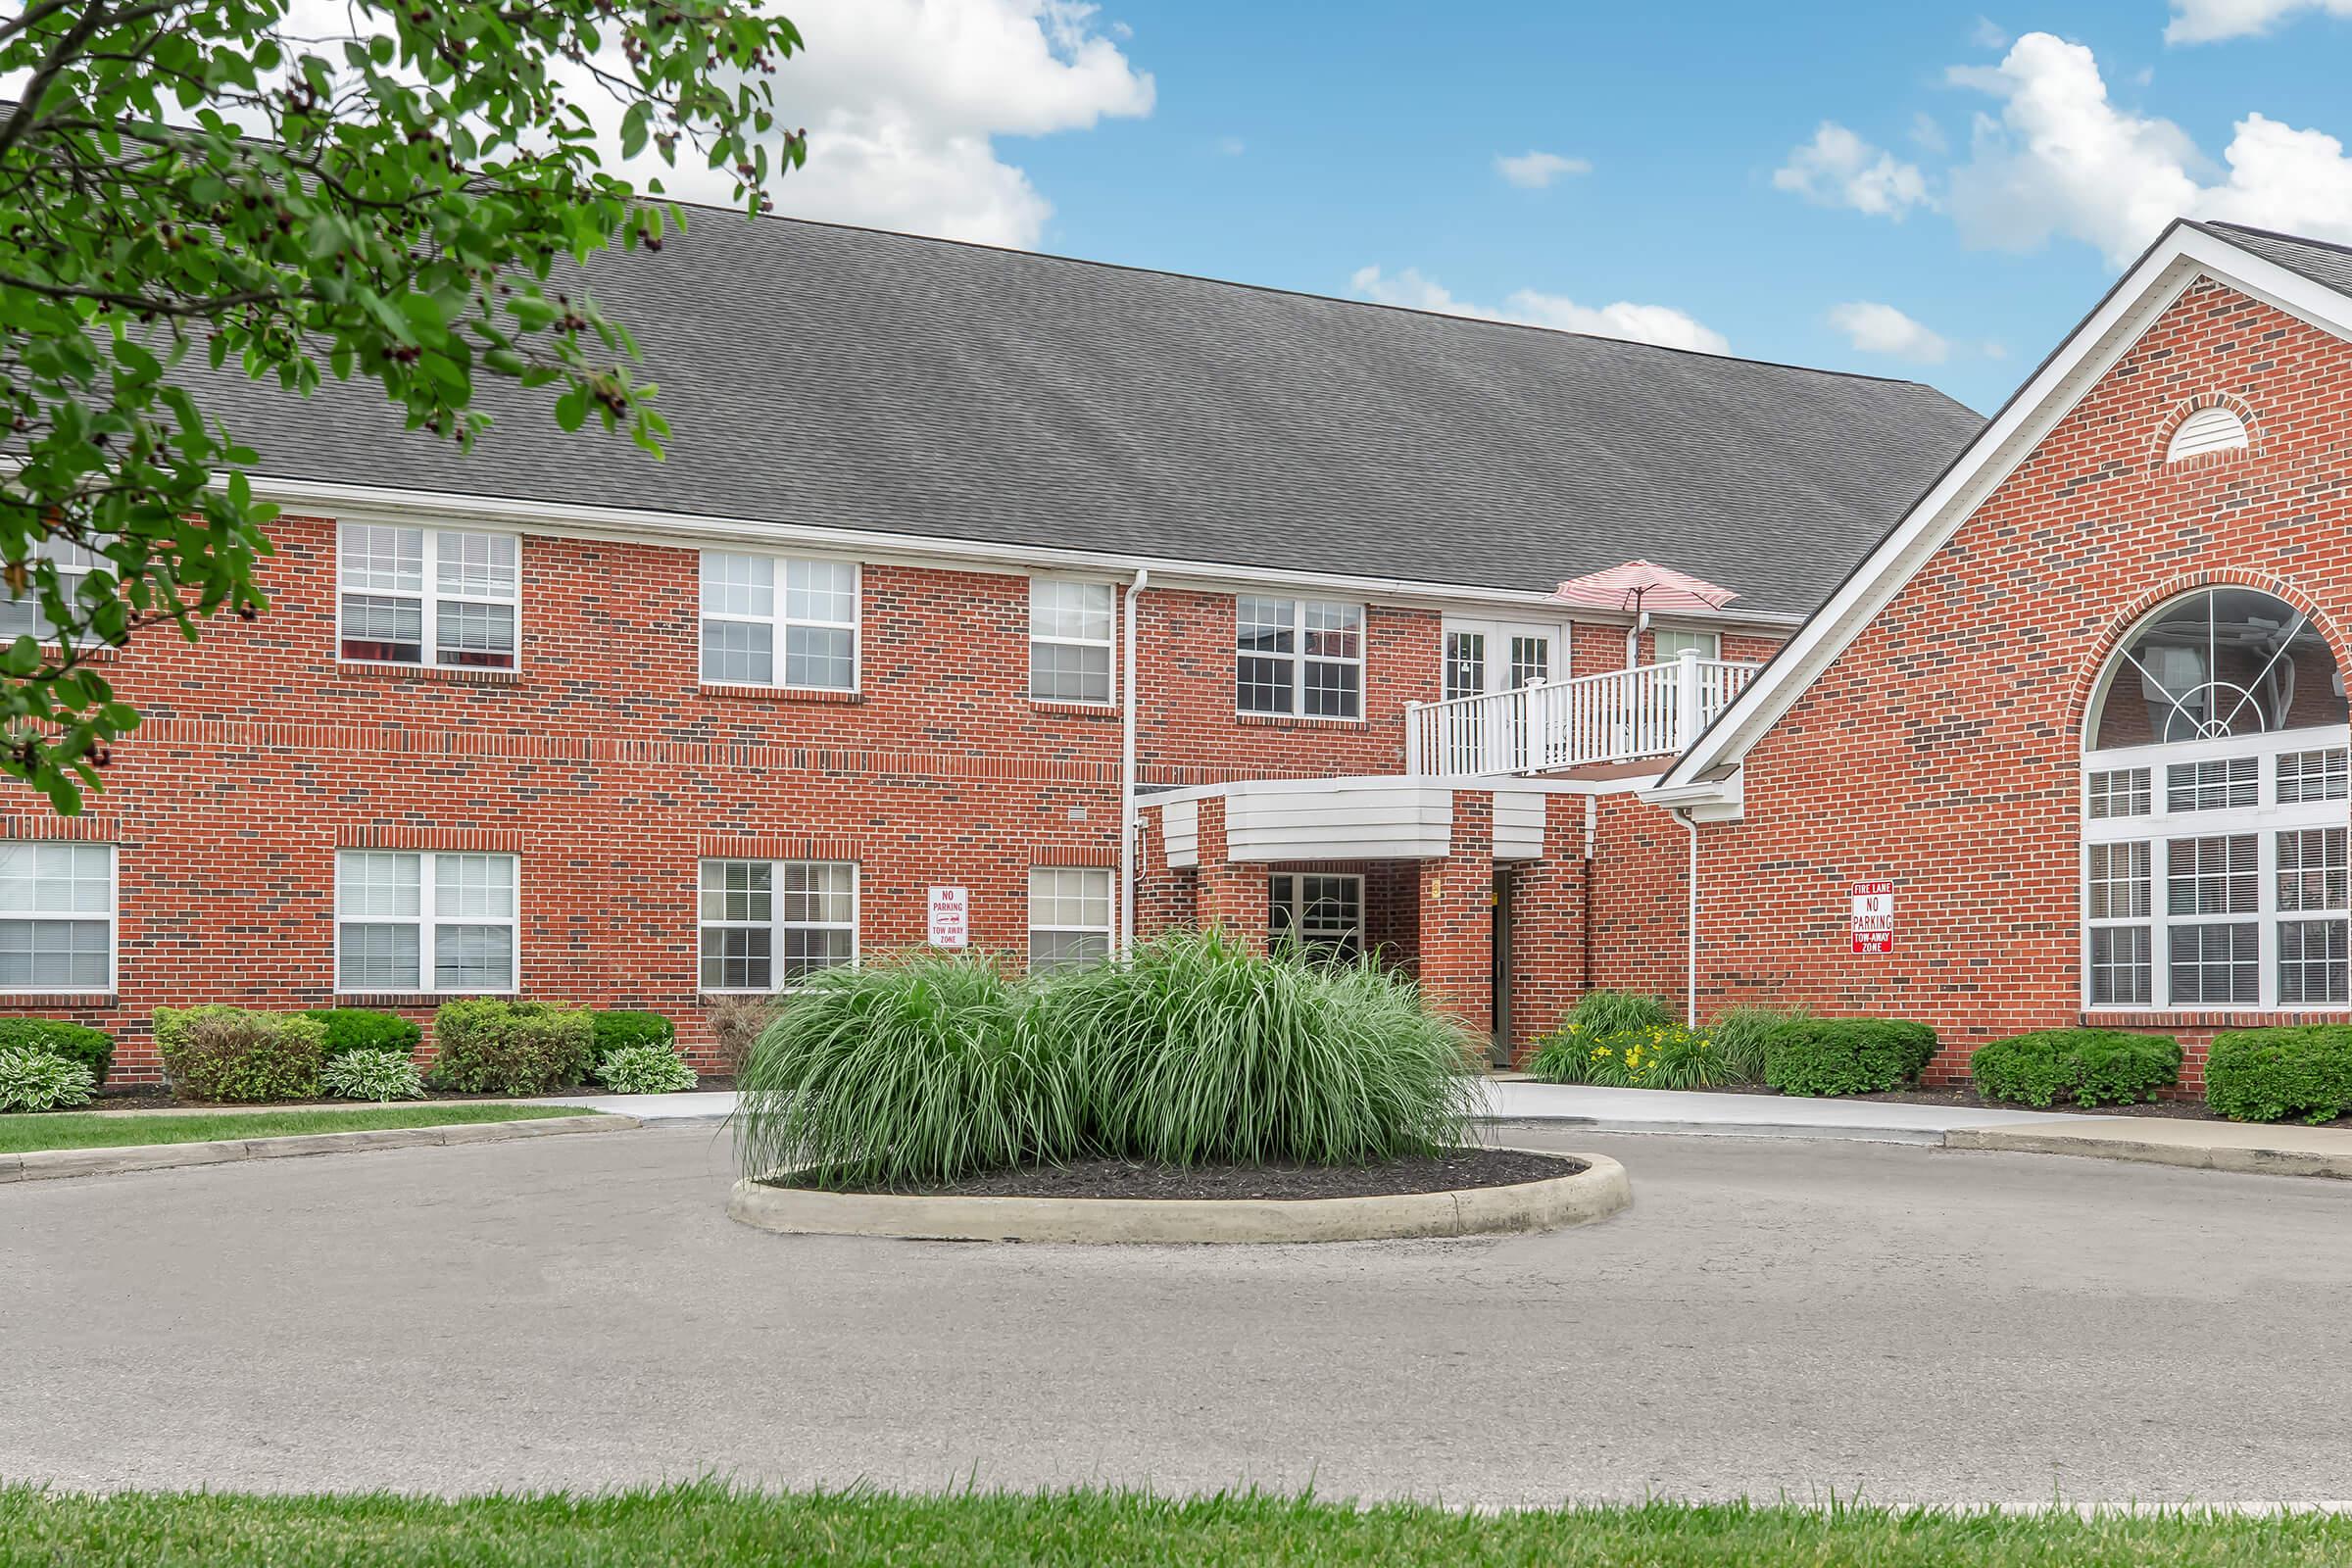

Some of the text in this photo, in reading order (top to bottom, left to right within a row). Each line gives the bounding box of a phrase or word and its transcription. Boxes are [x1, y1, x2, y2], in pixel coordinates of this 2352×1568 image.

[1854, 883, 1891, 894] FIRE LANE
[942, 890, 954, 901] NO
[934, 903, 963, 911] PARKING
[1866, 897, 1879, 911] NO
[1853, 914, 1891, 930] PARKING
[1862, 943, 1882, 953] ZONE
